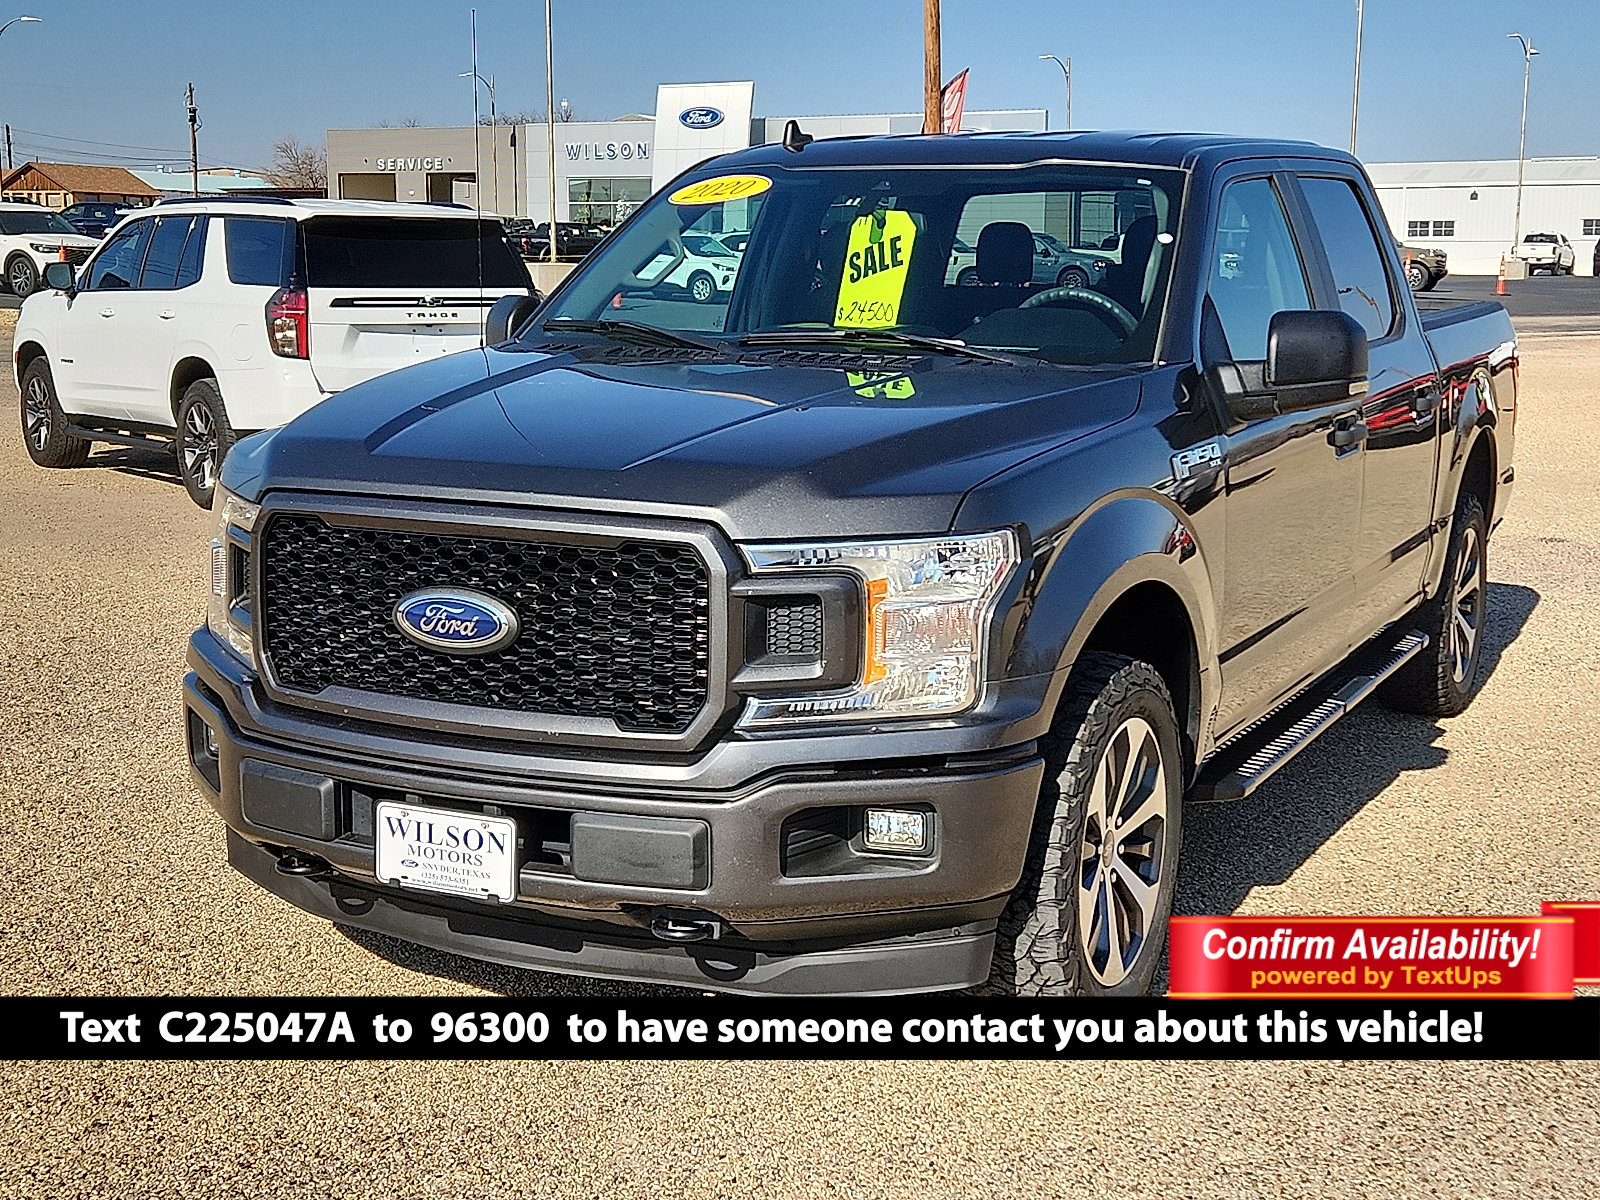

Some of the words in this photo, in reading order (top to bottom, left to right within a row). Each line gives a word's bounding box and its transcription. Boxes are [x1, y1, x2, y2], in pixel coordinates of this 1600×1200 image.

[686, 110, 713, 123] Ford
[566, 142, 649, 160] WILSON
[376, 157, 444, 172] SERVICE
[680, 181, 757, 200] 2020
[849, 235, 904, 284] SALE
[420, 604, 480, 636] Ford
[385, 816, 508, 855] WILSON
[407, 844, 483, 867] MOTORS
